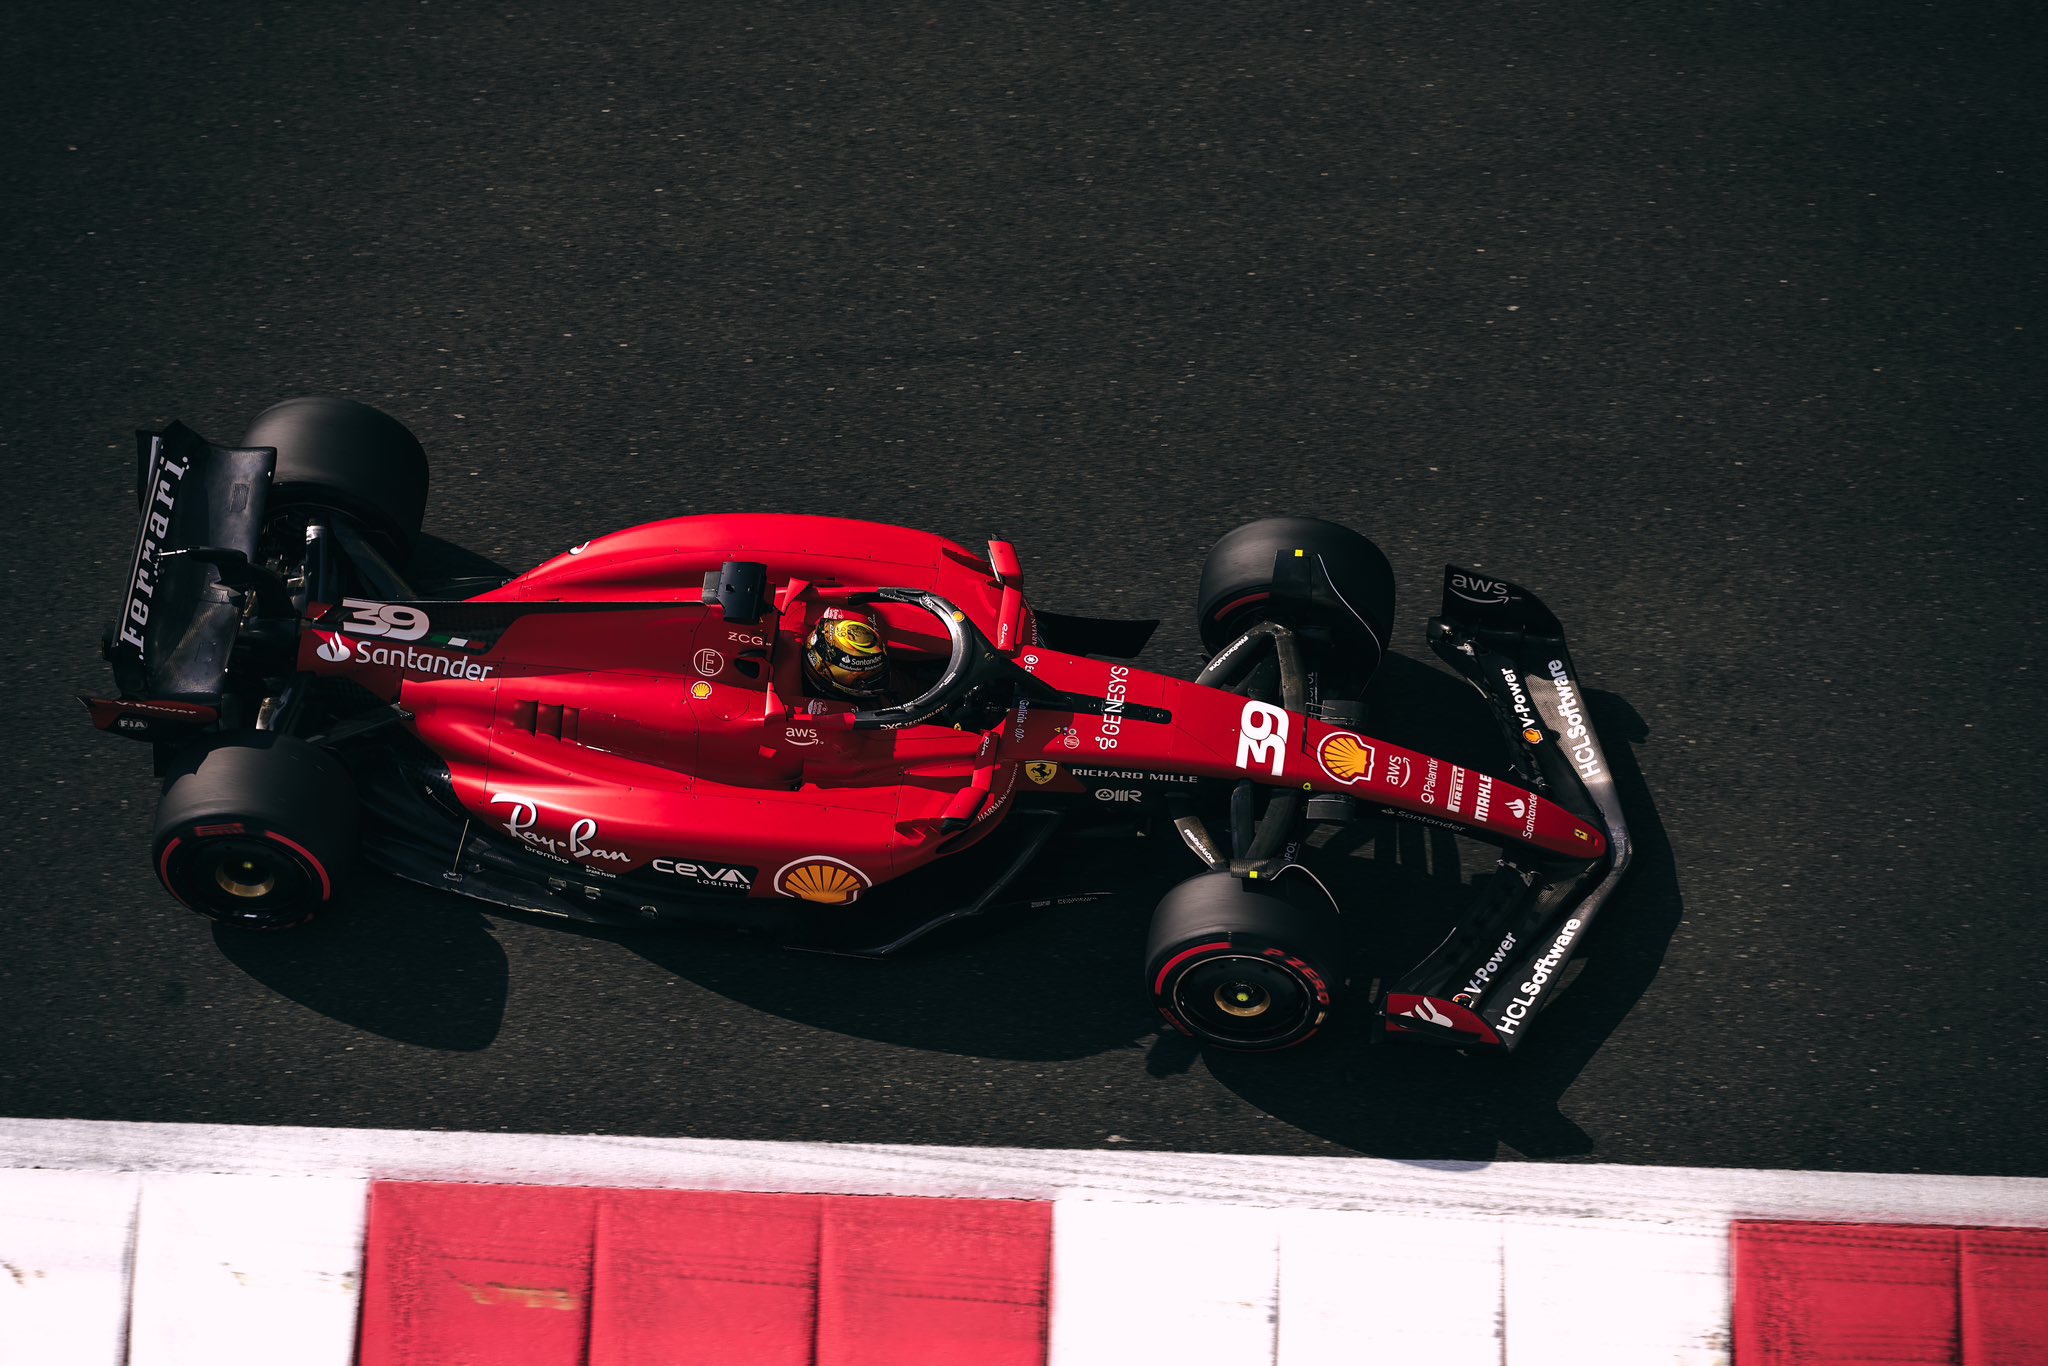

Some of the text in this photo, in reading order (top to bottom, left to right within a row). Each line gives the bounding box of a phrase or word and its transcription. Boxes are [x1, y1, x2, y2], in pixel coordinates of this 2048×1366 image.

[119, 455, 186, 653] Ferrari
[1452, 573, 1508, 595] aws
[342, 598, 430, 641] 39
[727, 631, 763, 646] ZCG
[355, 641, 494, 682] Santander
[851, 655, 882, 667] Santander
[880, 703, 950, 731] DXC TECHNOLOGY
[1101, 665, 1129, 736] GENESYS
[1500, 667, 1536, 728] V-Power
[119, 719, 146, 729] FIA
[1236, 700, 1290, 777] 39
[1547, 659, 1601, 779] HCLSoftware
[1071, 768, 1198, 784] RICHARD MILLE
[1386, 754, 1402, 786] aws
[1423, 757, 1439, 794] Palantir
[1447, 765, 1465, 813] PIRELLI
[977, 794, 1007, 822] HARMAN
[1474, 773, 1493, 823] MAHLE
[1522, 792, 1538, 839] Santander
[490, 793, 632, 863] Ray-Ban
[1397, 810, 1467, 832] Santander
[524, 845, 570, 865] brembo
[696, 878, 751, 890] LOGISTICS
[1284, 957, 1332, 1005] ZERO
[1464, 931, 1517, 995] V-Power
[1495, 917, 1582, 1035] HCLSoftware
